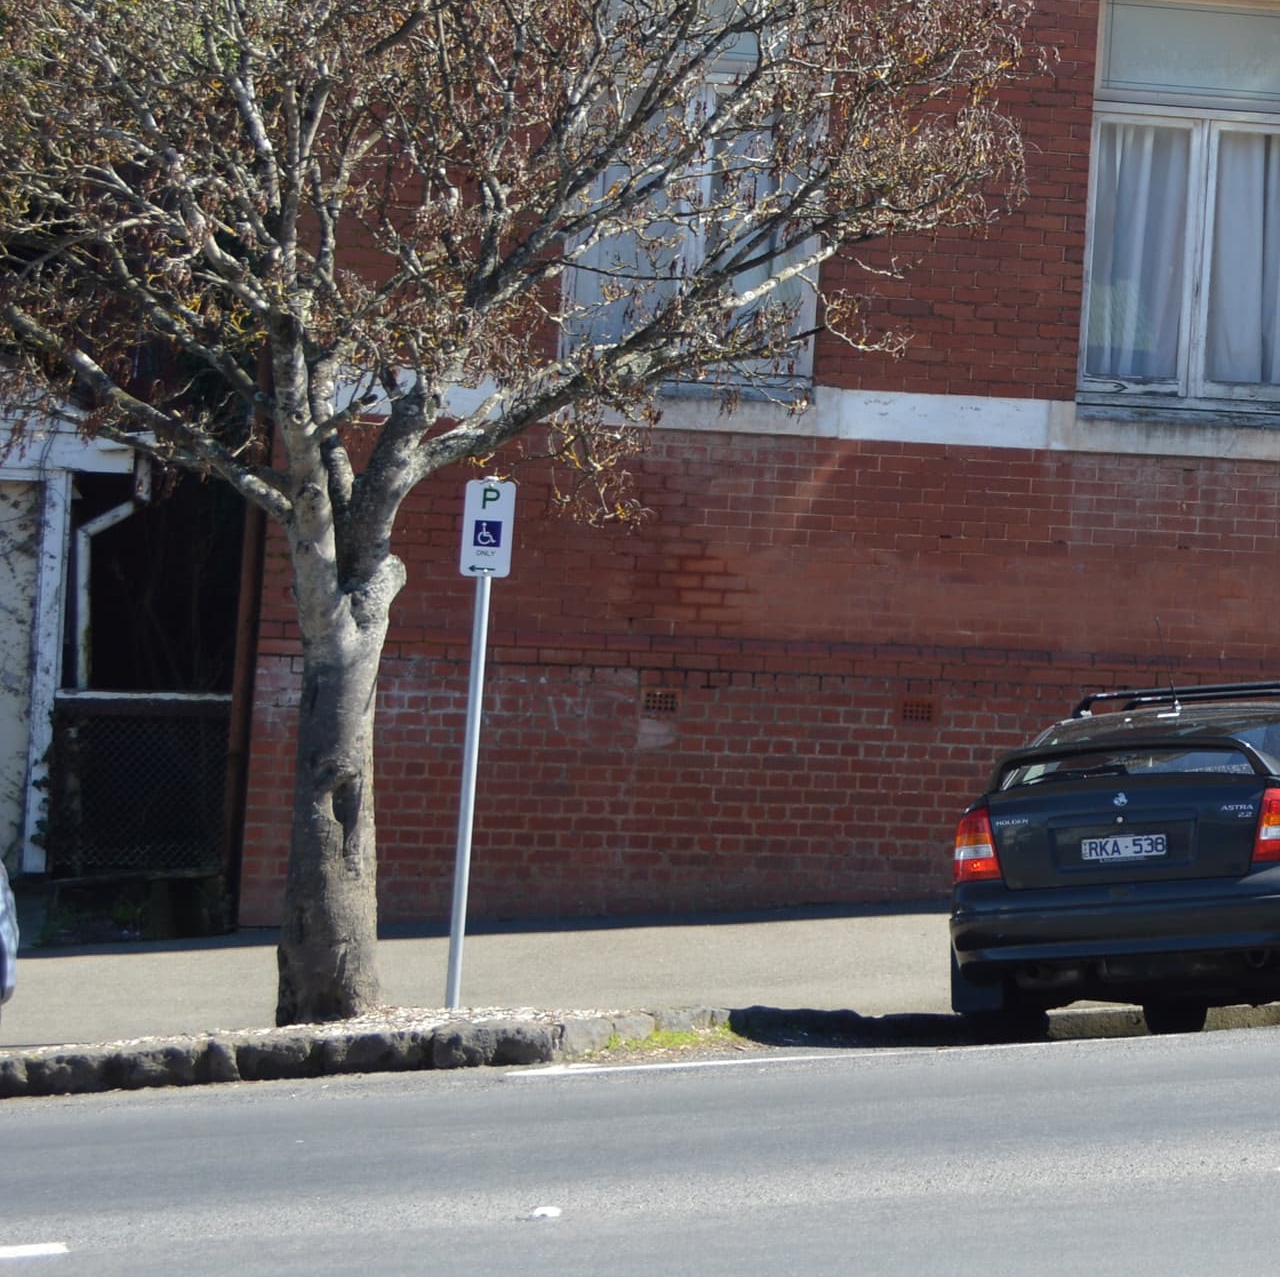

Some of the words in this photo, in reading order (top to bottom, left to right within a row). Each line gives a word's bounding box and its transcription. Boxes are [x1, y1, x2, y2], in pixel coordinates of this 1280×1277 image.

[481, 488, 500, 509] P
[475, 549, 496, 557] ONLY
[1220, 803, 1254, 812] ASTRA
[995, 818, 1029, 827] HOLDEN
